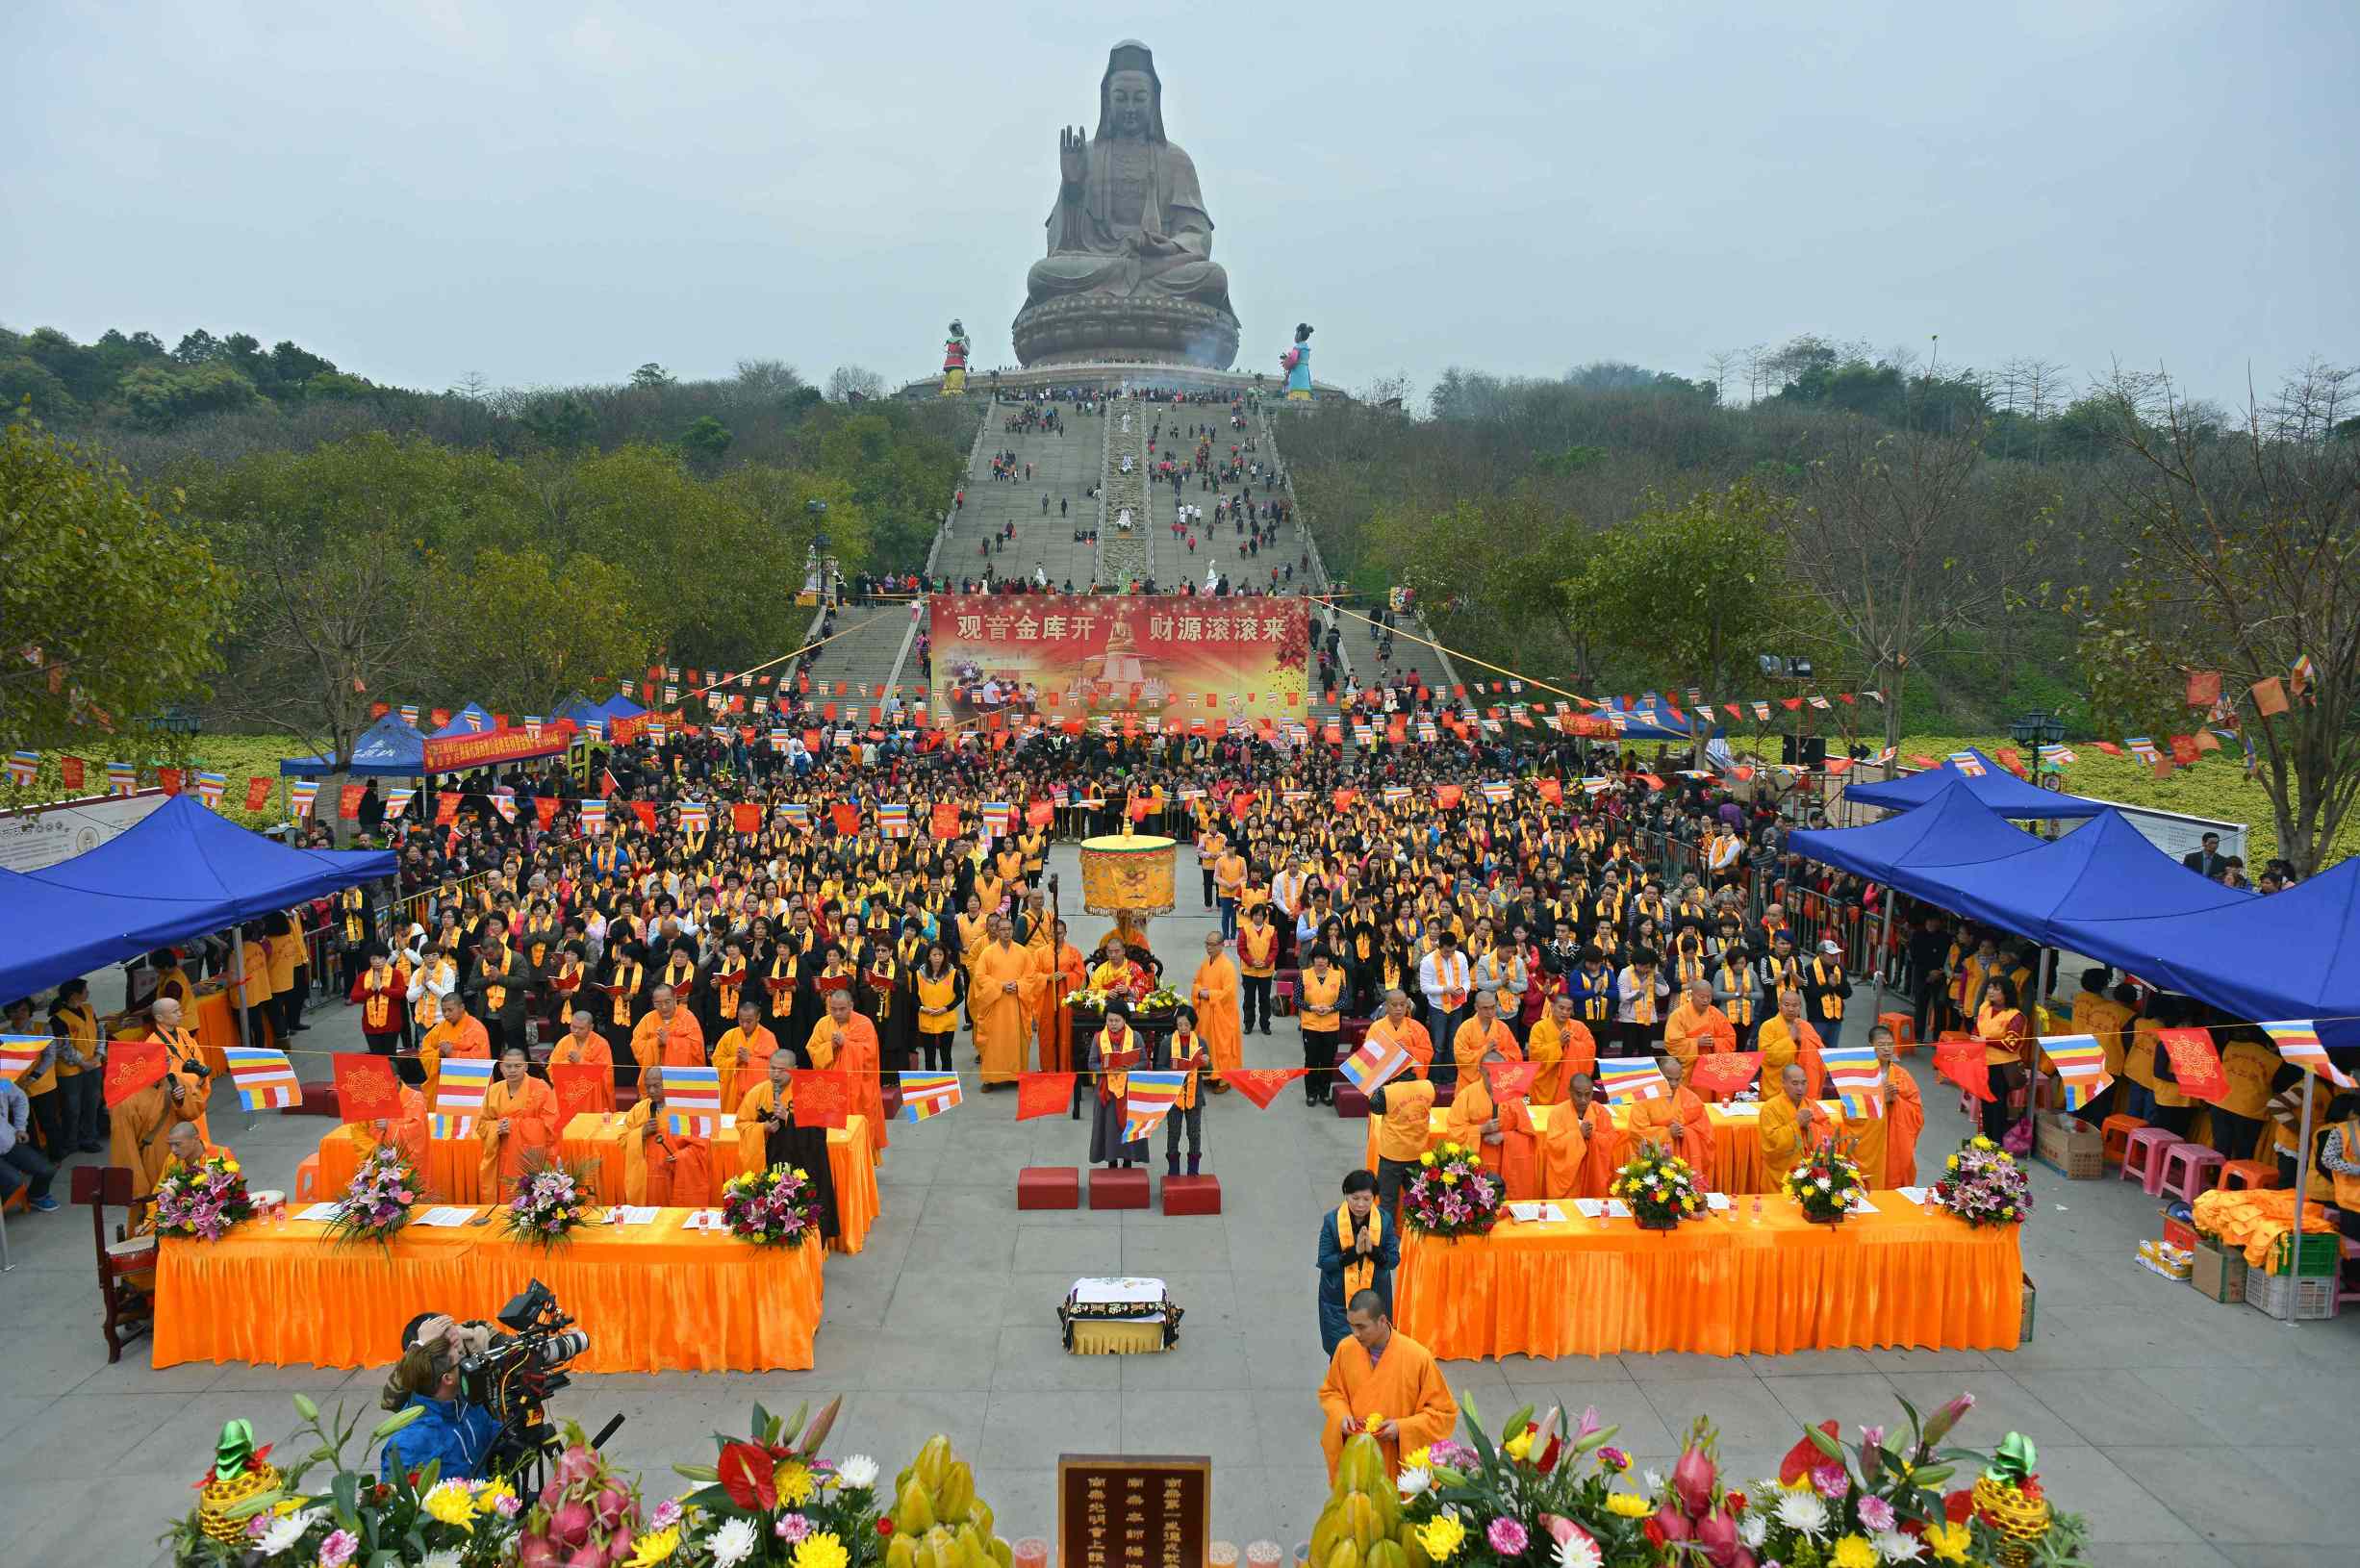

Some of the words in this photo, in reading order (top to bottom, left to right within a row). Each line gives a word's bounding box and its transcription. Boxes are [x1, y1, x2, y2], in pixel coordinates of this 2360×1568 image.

[956, 615, 1096, 641] 观音金库开
[1149, 616, 1286, 643] 财源滚滚来
